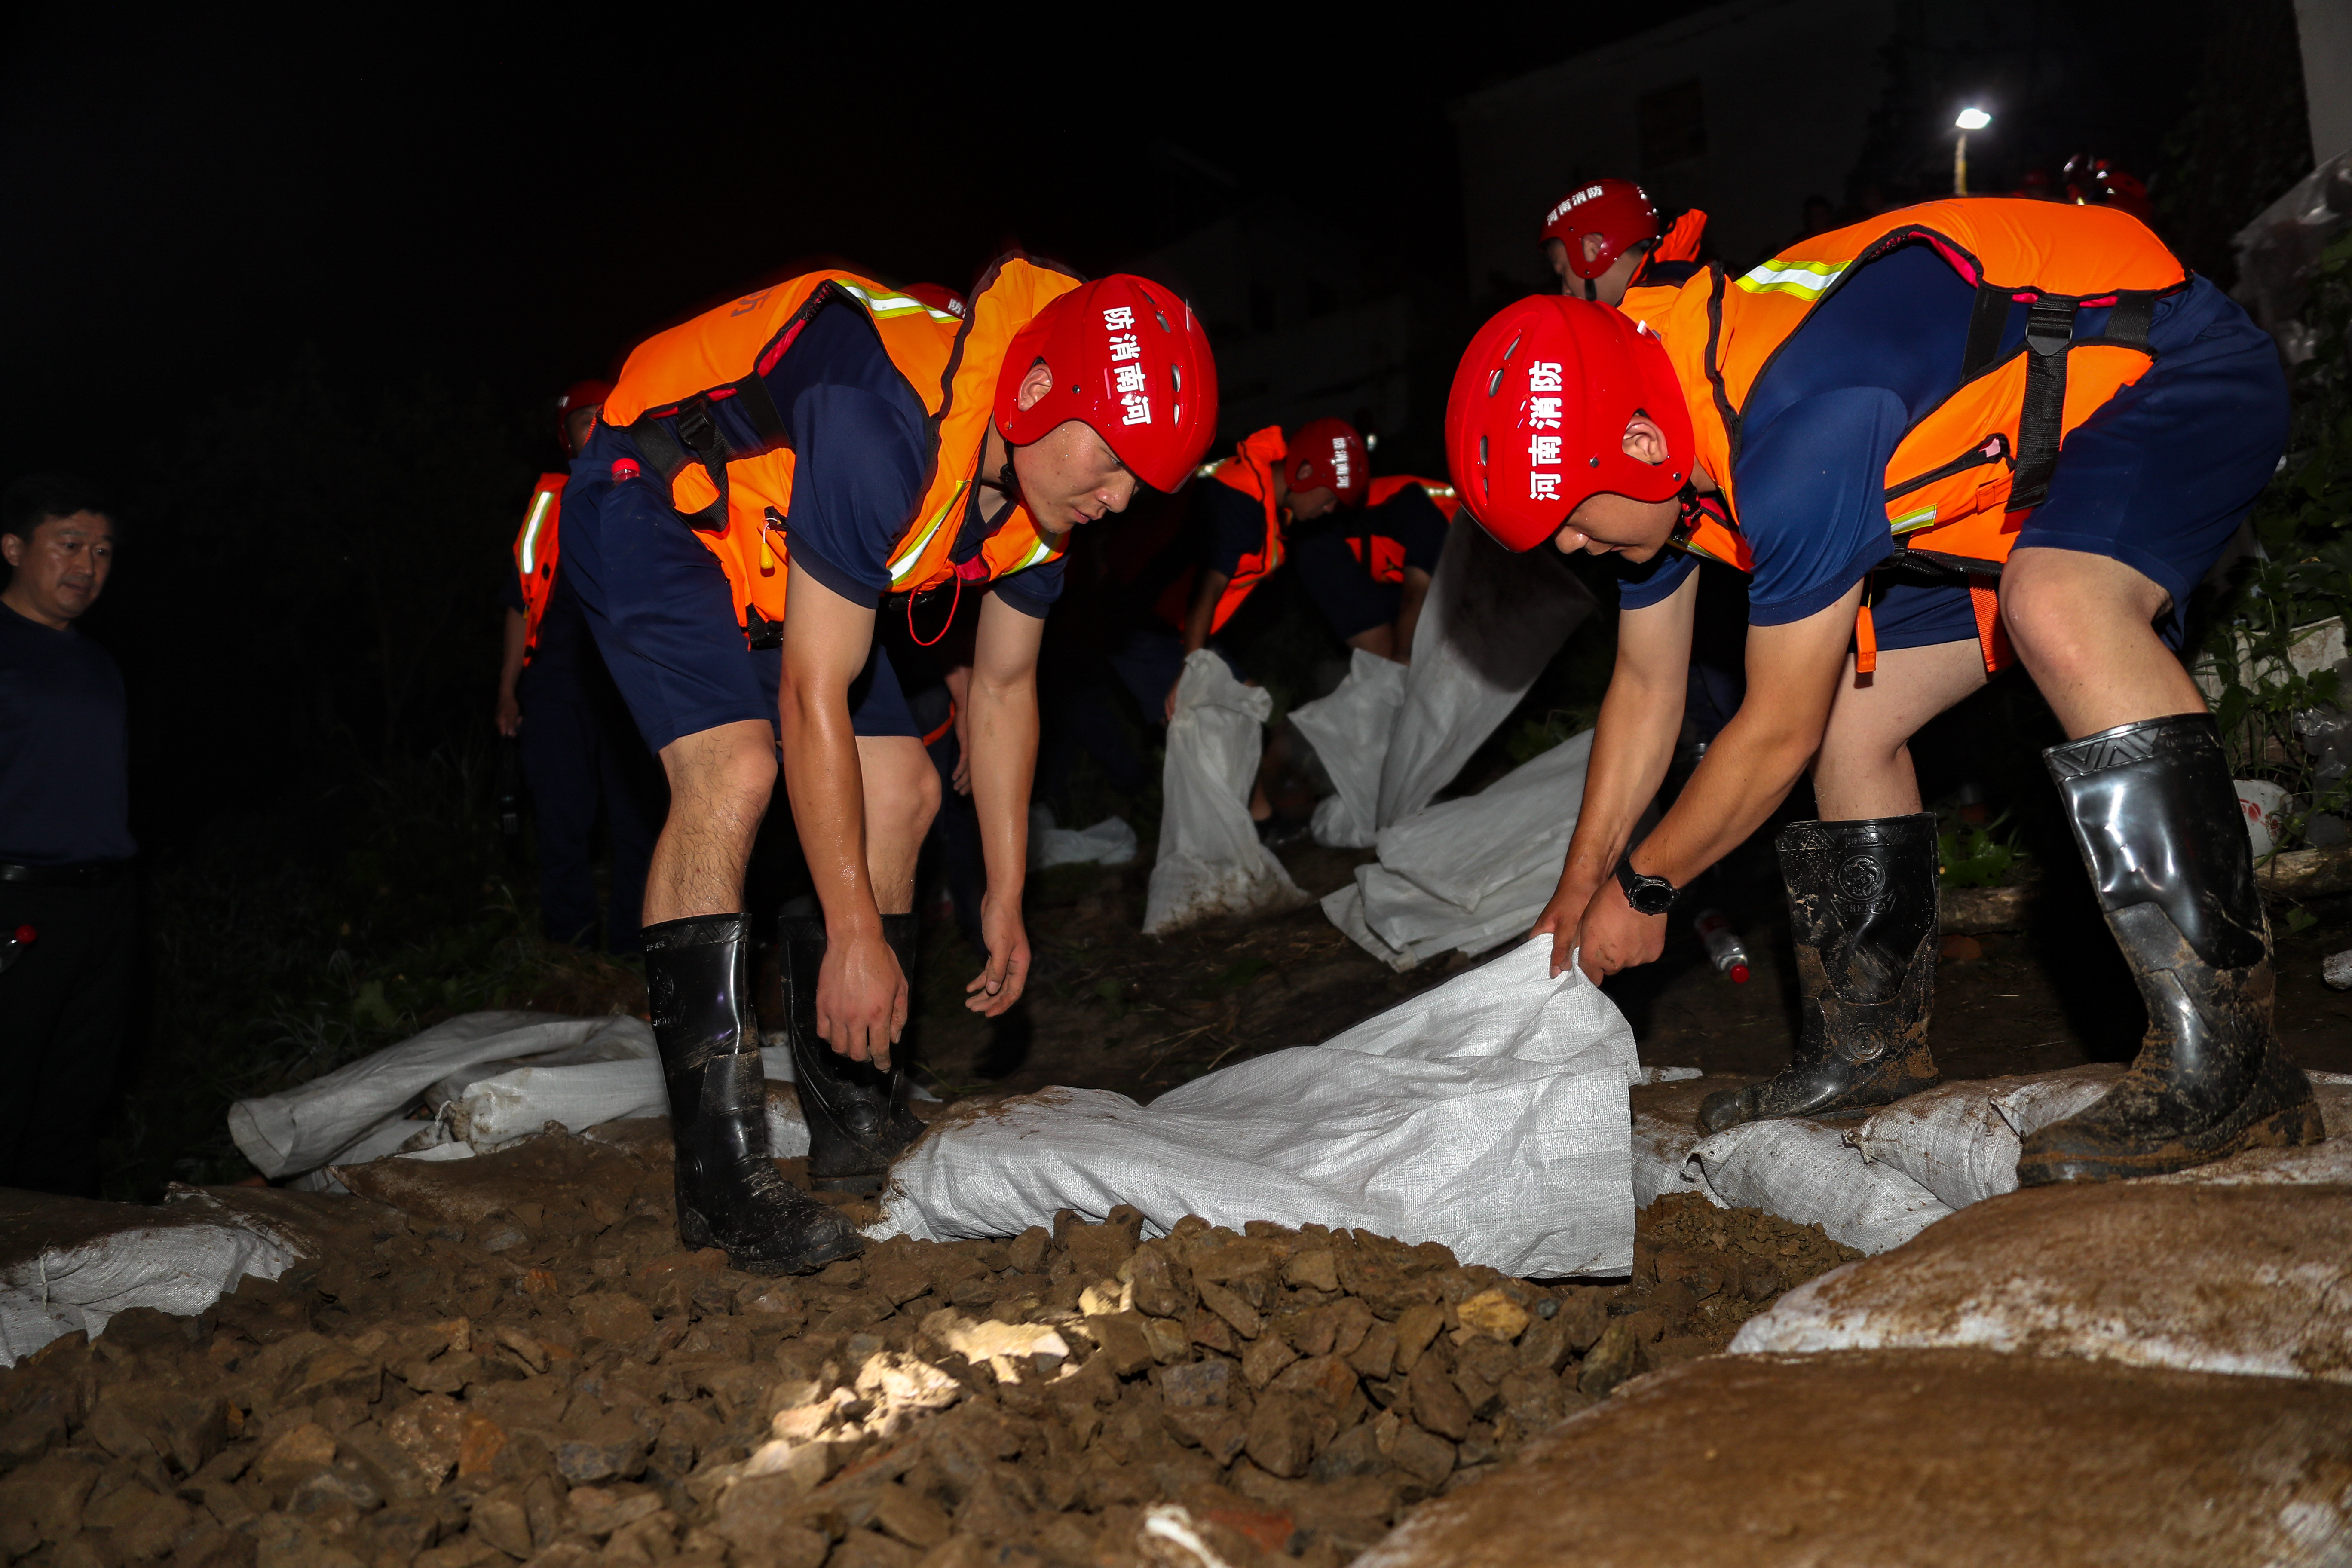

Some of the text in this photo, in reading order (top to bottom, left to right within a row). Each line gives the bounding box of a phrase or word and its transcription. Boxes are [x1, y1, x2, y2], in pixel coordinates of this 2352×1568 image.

[1547, 185, 1604, 227] 河南消防
[1528, 361, 1562, 501] 河南消防
